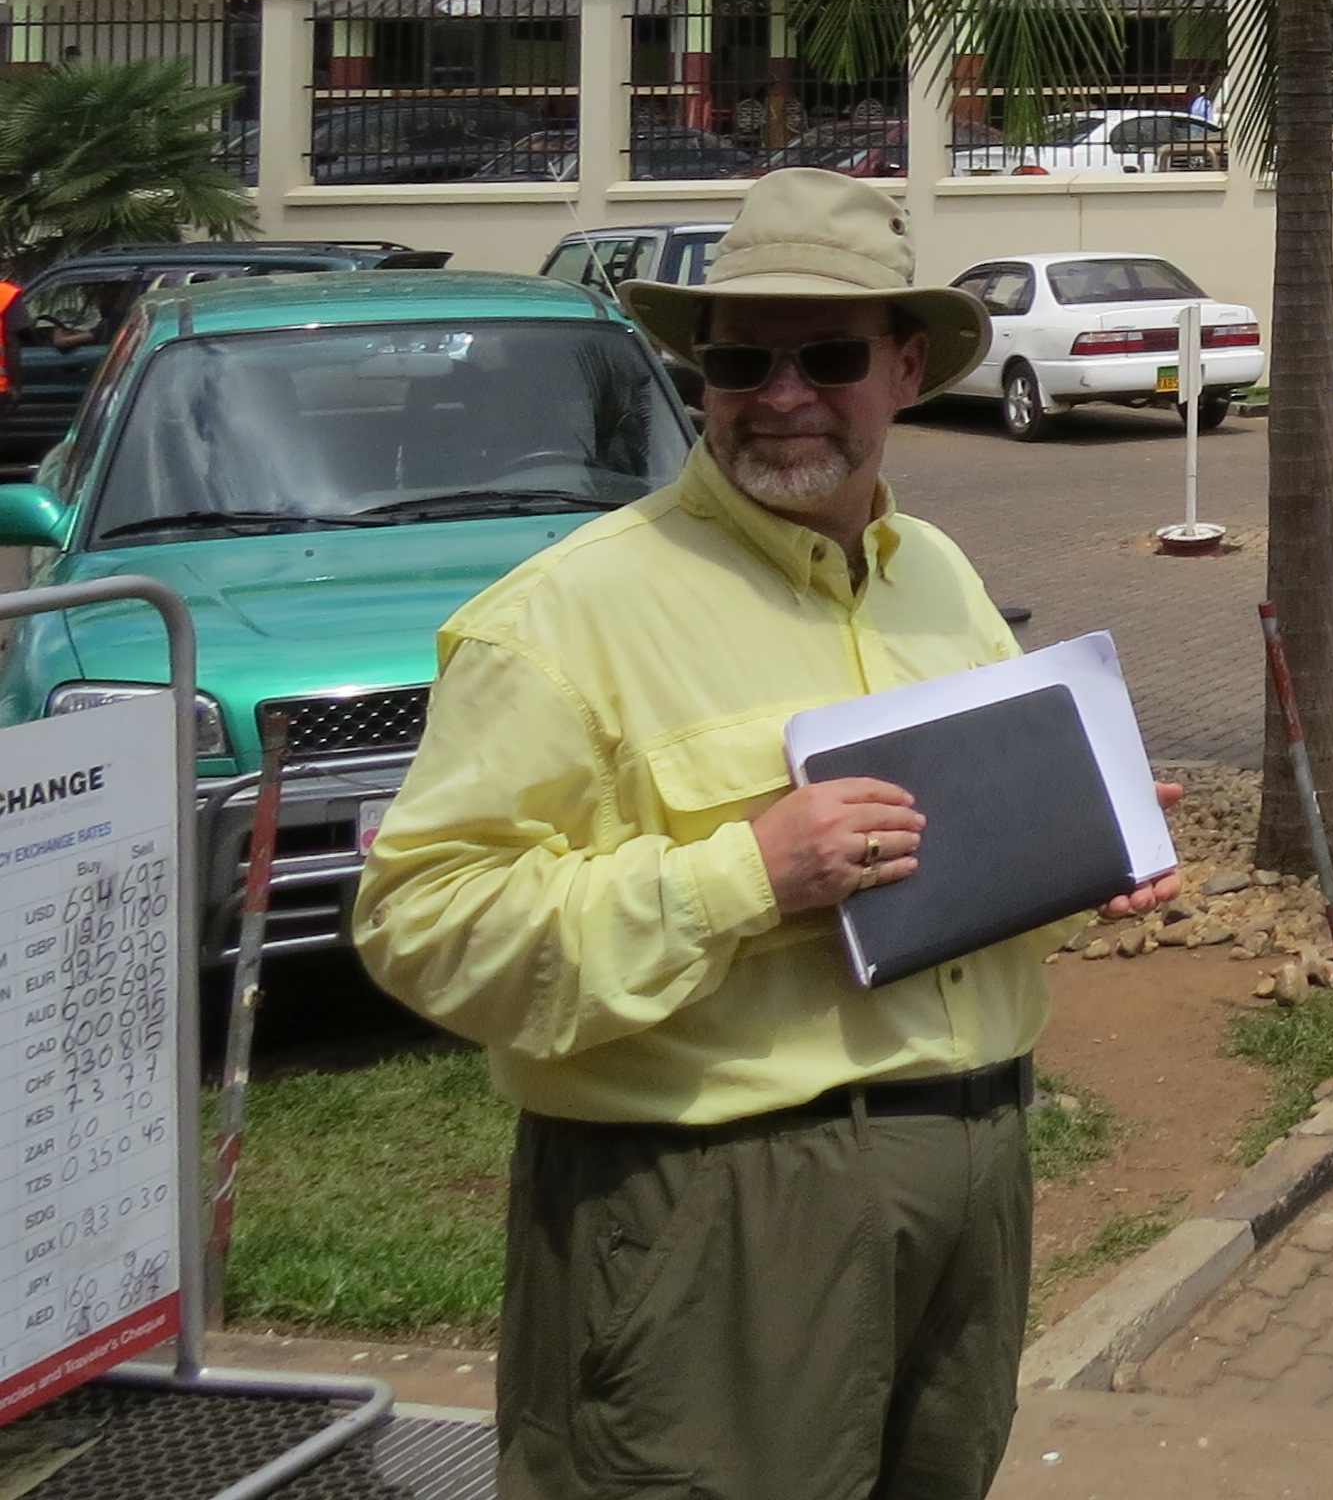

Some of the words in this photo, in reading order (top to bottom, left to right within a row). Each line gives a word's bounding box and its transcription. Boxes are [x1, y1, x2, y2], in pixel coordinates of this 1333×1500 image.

[78, 821, 112, 842] RATES
[77, 861, 101, 876] Buy
[131, 841, 154, 859] Sell
[25, 903, 56, 925] USD
[25, 936, 56, 959] GBP
[26, 970, 56, 993] EUR
[25, 1003, 56, 1027] AUD
[25, 1037, 57, 1060] CAD
[25, 1069, 56, 1094] CHF
[25, 1105, 55, 1128] KES
[24, 1137, 55, 1163] ZAR
[25, 1173, 53, 1194] TZS
[25, 1205, 56, 1230] SDG
[25, 1236, 56, 1263] UGX
[25, 1270, 53, 1297] JPY
[25, 1305, 55, 1329] AED
